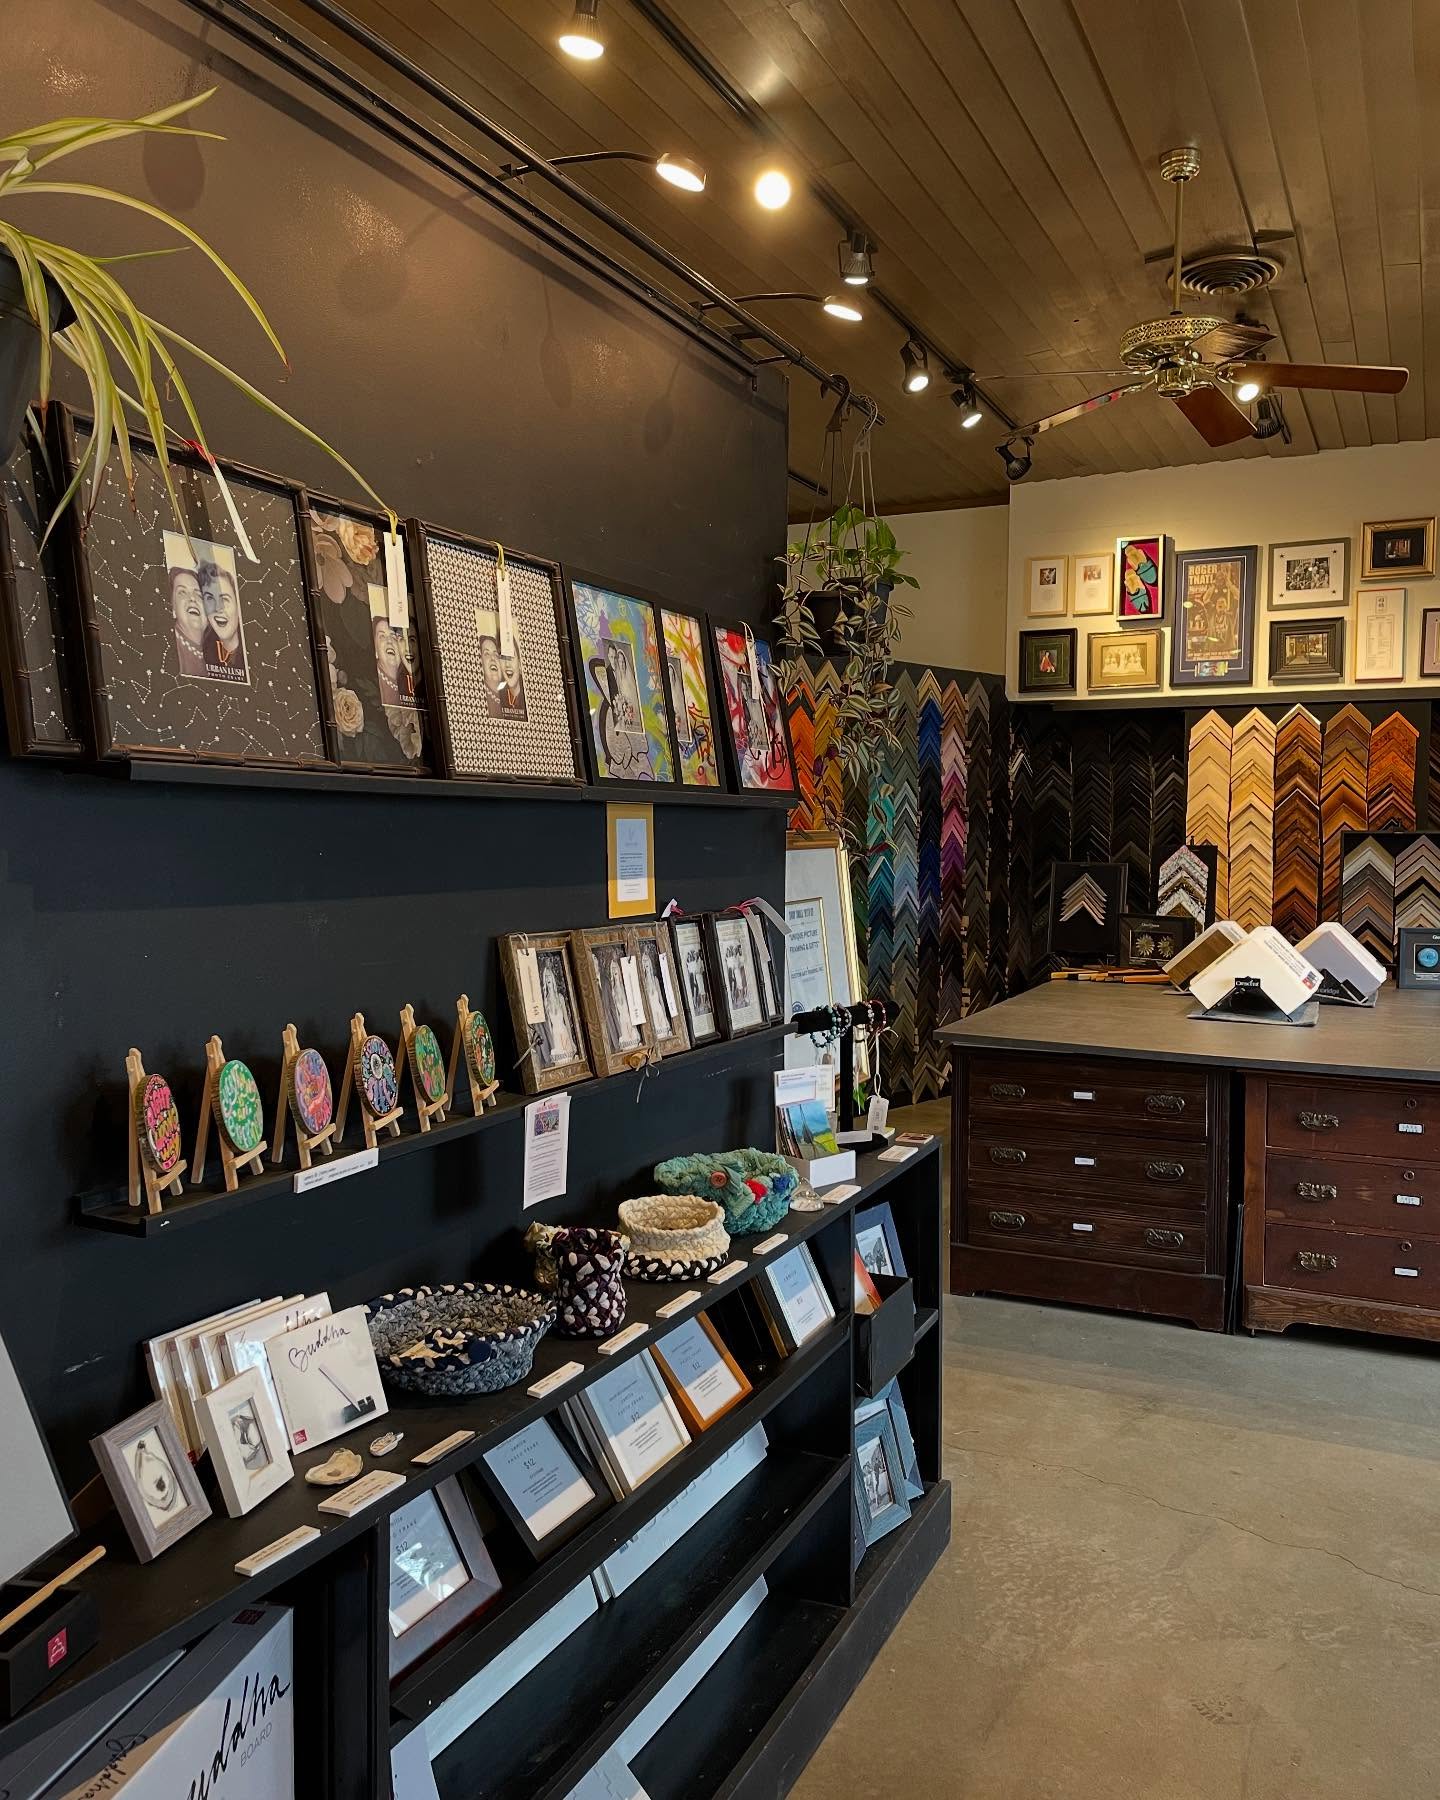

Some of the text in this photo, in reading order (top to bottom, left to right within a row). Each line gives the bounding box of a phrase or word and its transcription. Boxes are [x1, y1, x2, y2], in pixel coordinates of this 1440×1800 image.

[1188, 564, 1218, 576] ROGER
[288, 1323, 351, 1372] Buddha
[523, 1457, 537, 1470] $12
[394, 1540, 409, 1556] $12
[187, 1672, 291, 1800] uddha
[240, 1721, 273, 1768] BOARD
